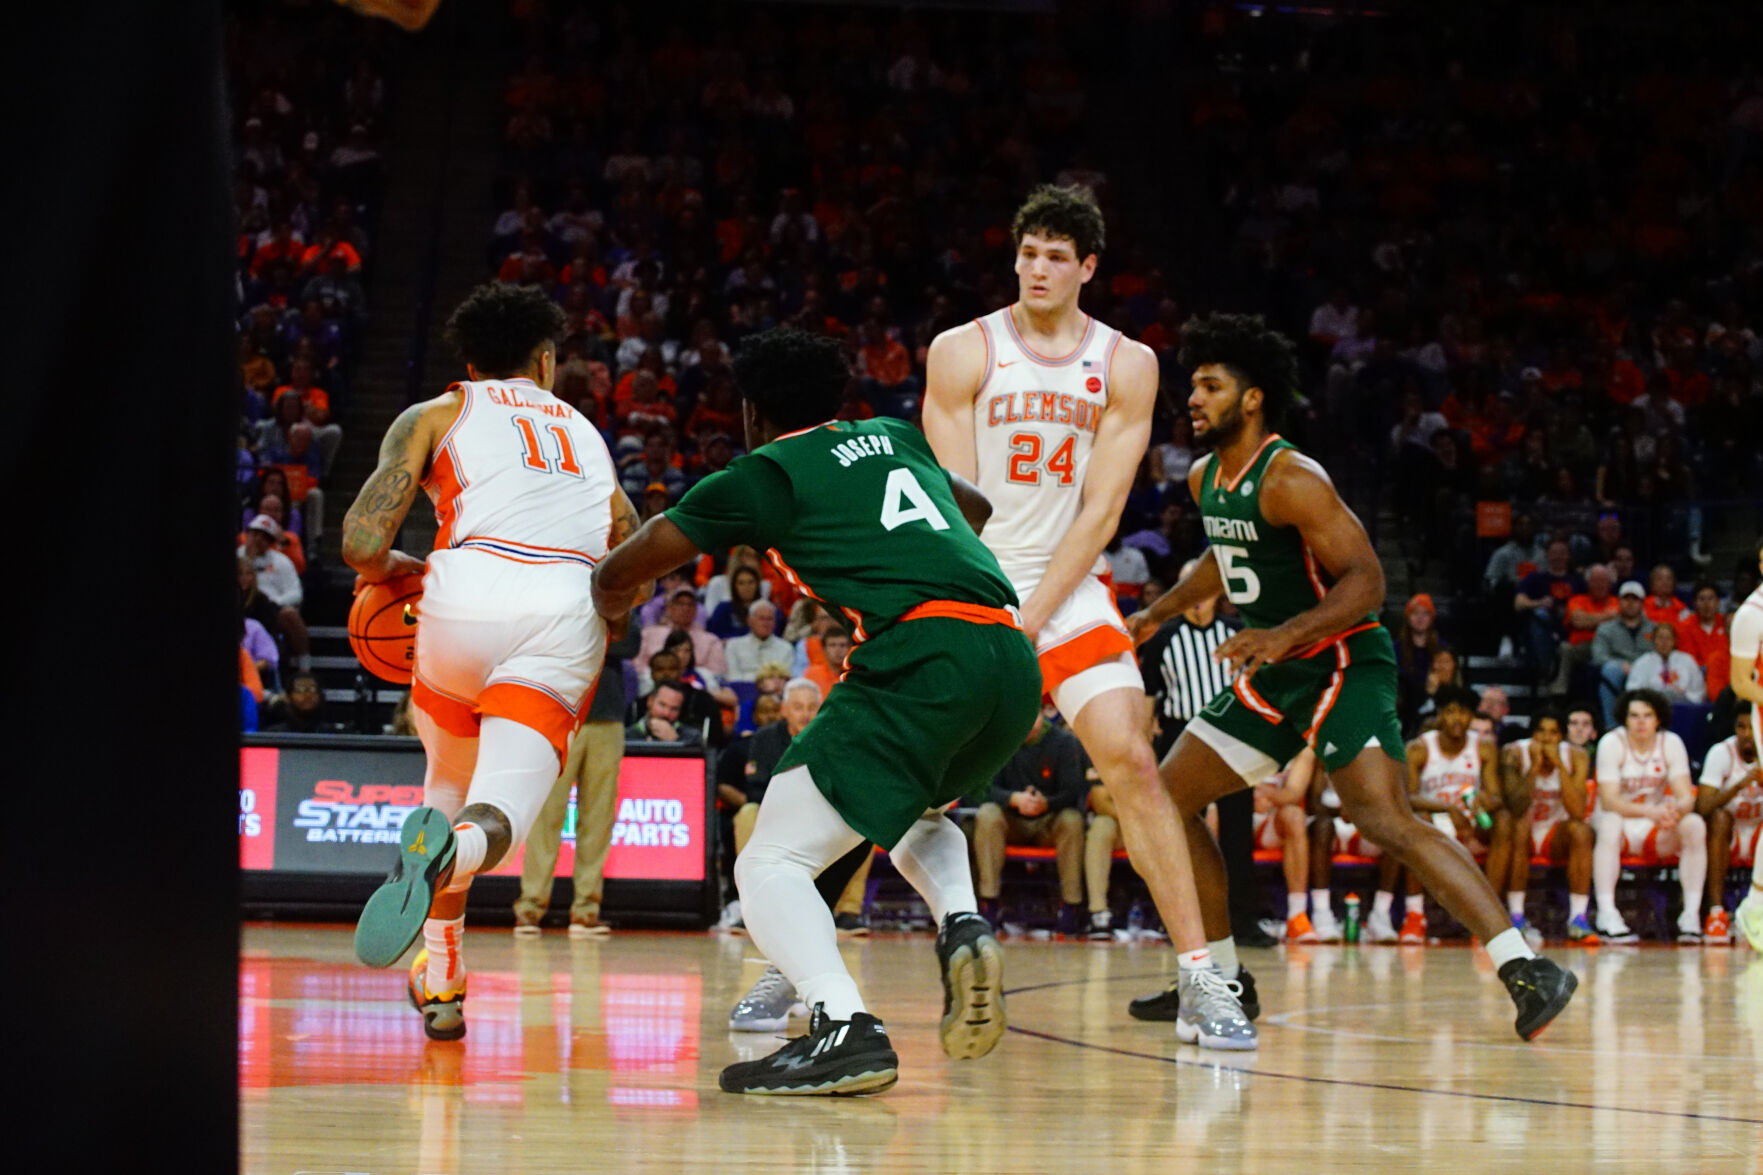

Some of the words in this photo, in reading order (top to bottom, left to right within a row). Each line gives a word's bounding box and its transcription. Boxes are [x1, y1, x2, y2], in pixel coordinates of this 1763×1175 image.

[988, 391, 1102, 432] CLEMSON
[511, 414, 585, 479] 11
[830, 434, 894, 467] JOSEPH
[1006, 430, 1079, 487] 24
[880, 467, 951, 531] 4
[1212, 543, 1261, 604] 15
[312, 780, 424, 805] SUPE
[617, 798, 683, 823] AUTO
[610, 822, 690, 847] PARTS
